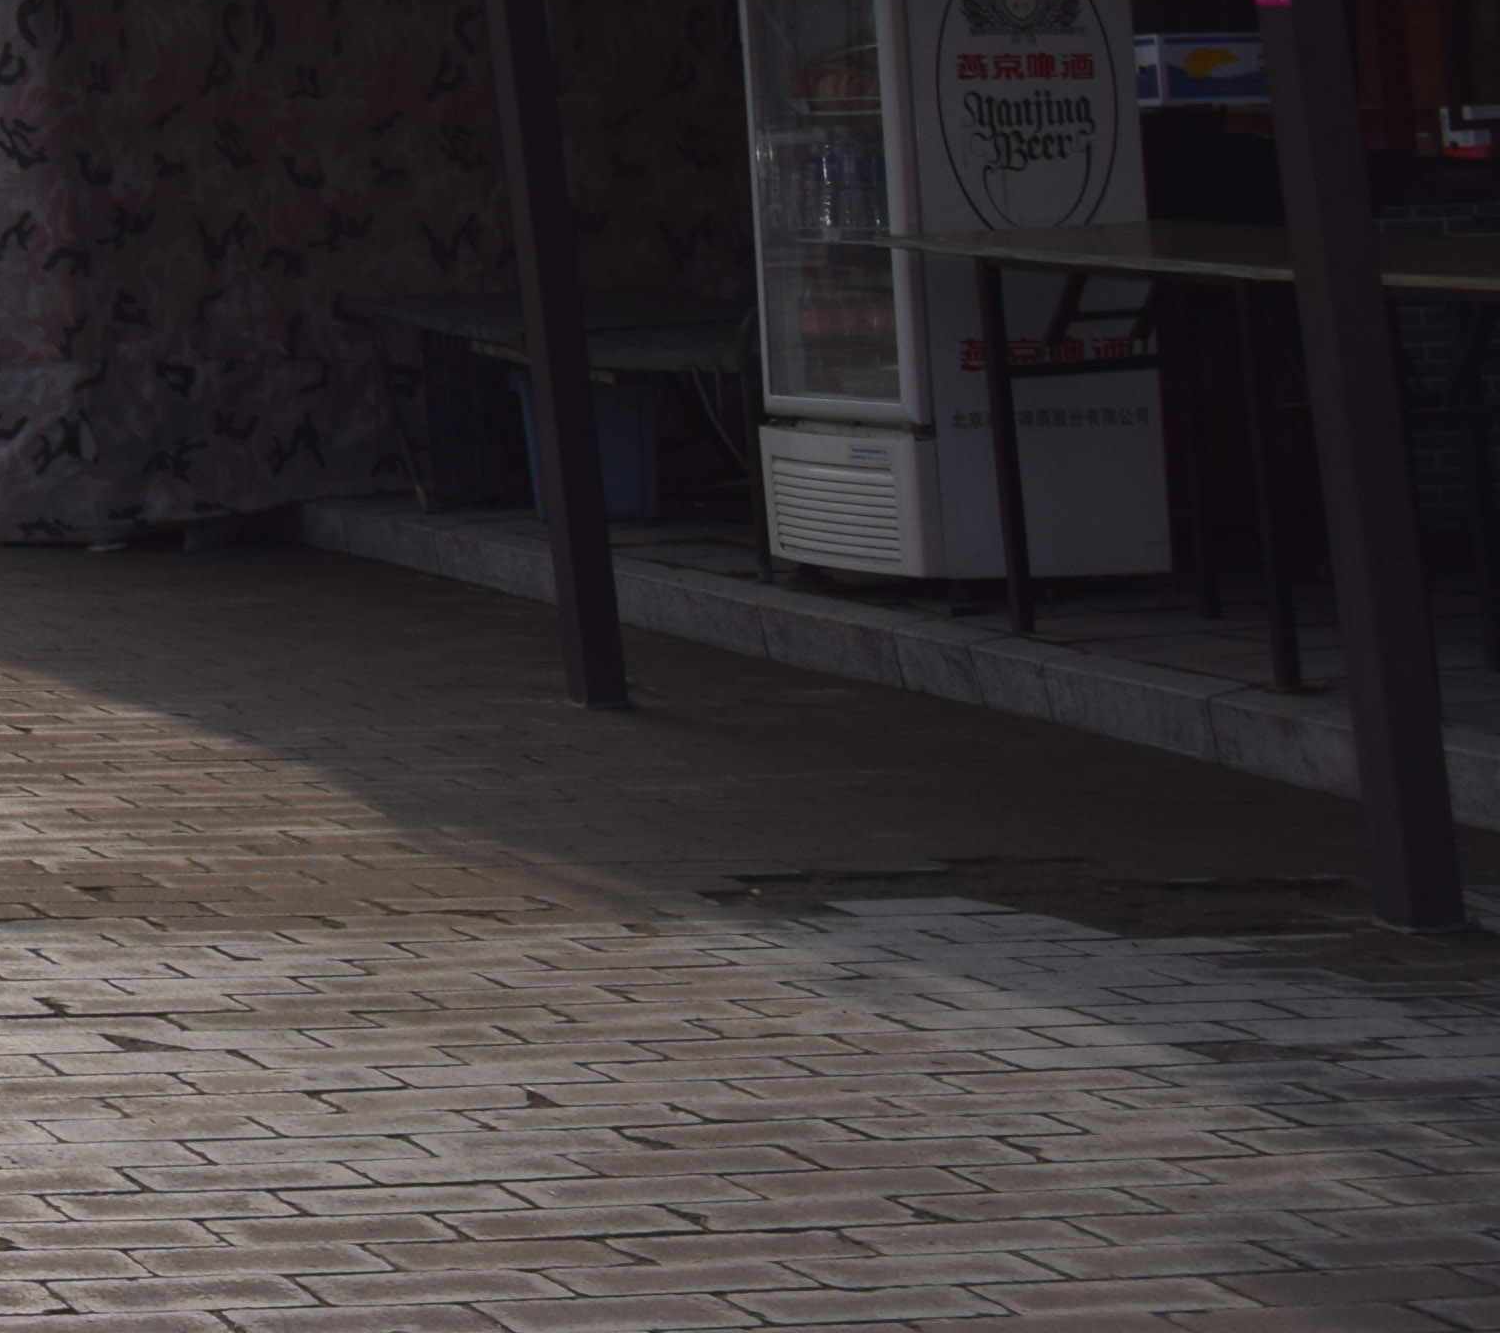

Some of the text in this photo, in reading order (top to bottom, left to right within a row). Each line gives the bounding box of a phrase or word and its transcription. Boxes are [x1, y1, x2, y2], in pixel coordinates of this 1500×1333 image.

[956, 53, 1096, 81] 燕京啤酒
[963, 90, 1097, 139] Yanjing
[972, 128, 1080, 172] Beer
[951, 406, 1151, 431] 北京啤酒股份有限公司
